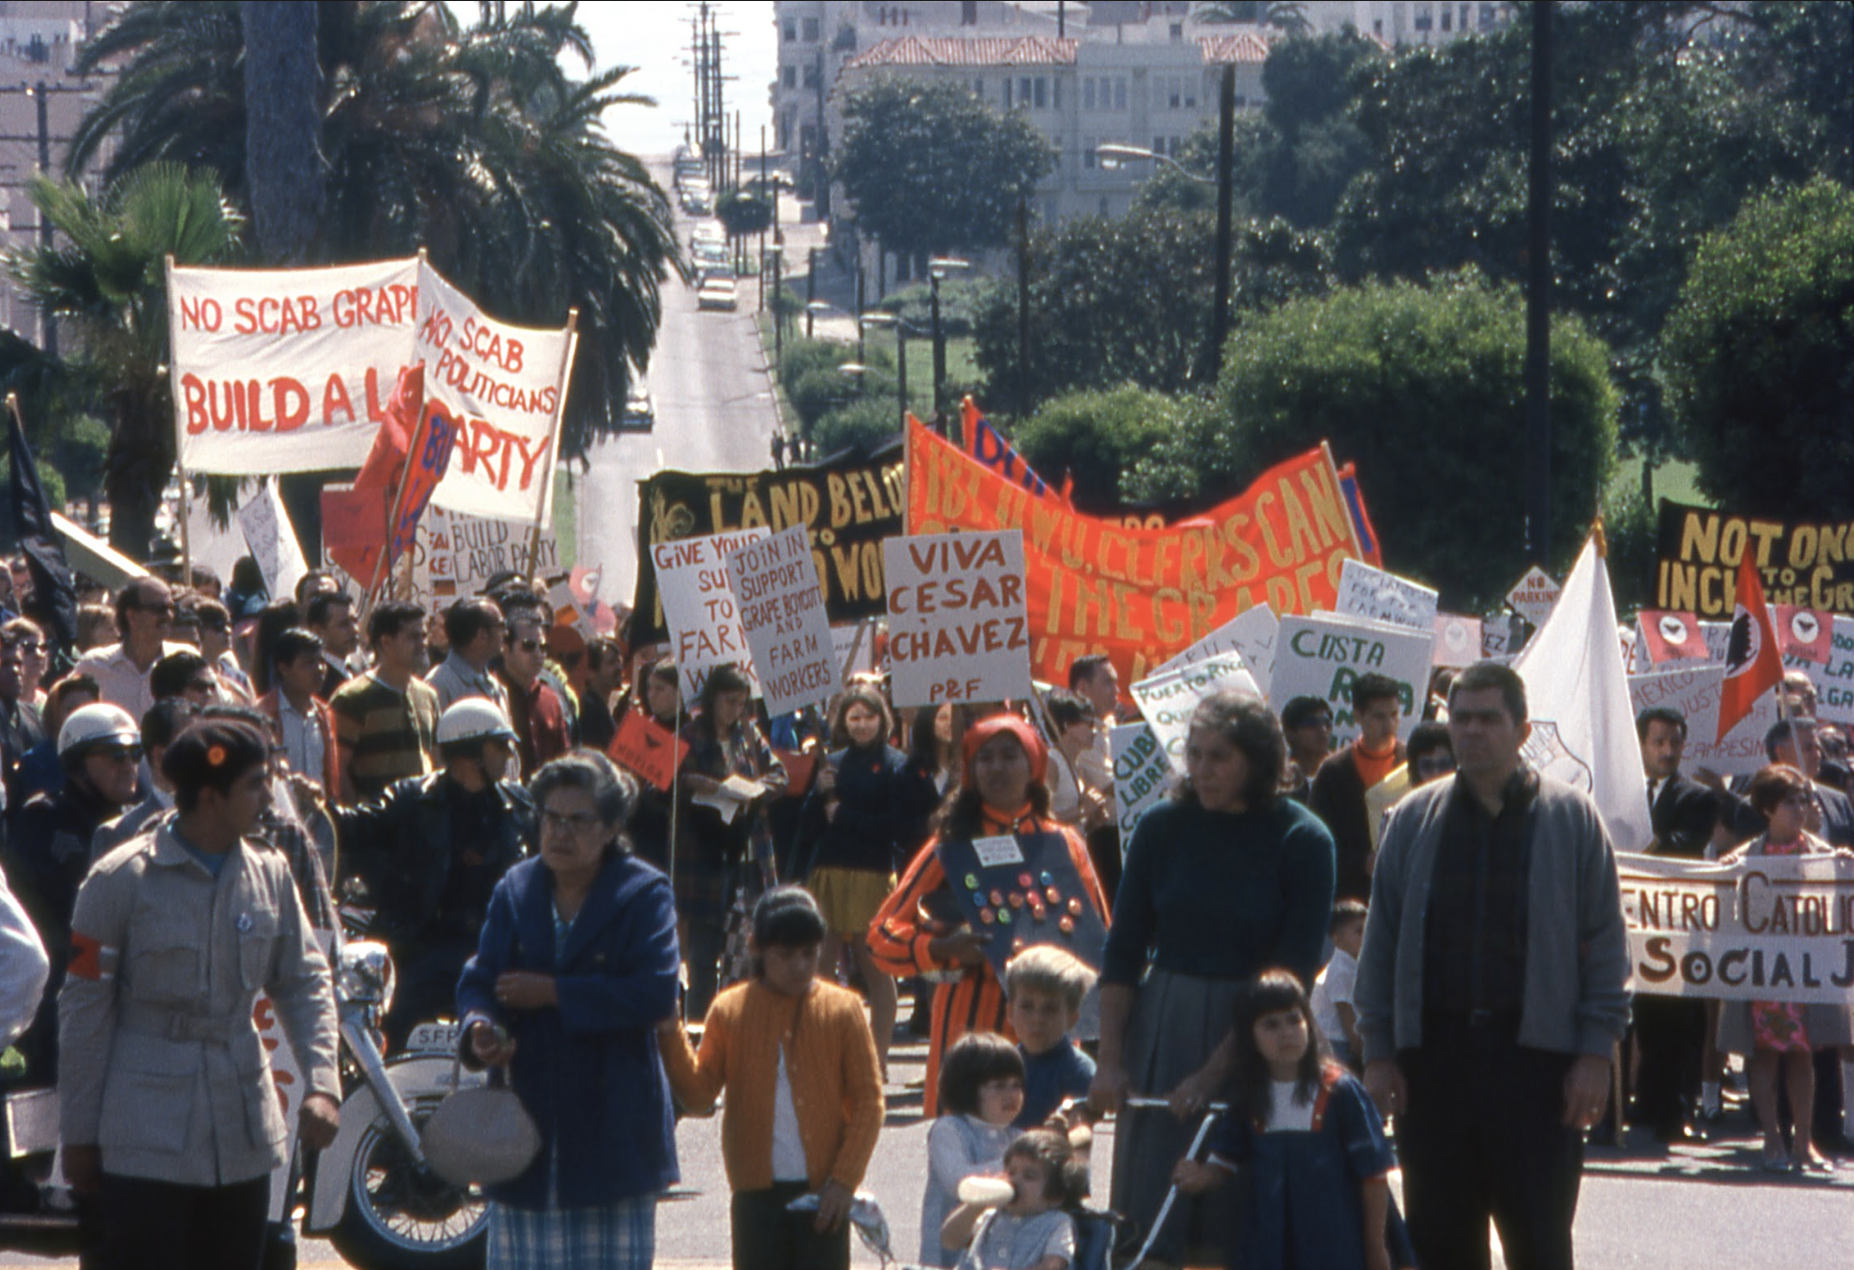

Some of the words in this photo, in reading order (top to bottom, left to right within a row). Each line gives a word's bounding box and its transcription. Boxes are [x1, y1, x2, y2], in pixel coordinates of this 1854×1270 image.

[181, 296, 222, 332] NO
[235, 295, 321, 335] SCAB
[418, 304, 453, 349] NO
[459, 316, 524, 374] SCAB
[434, 346, 557, 415] POLITICIANS
[181, 372, 310, 435] BUILD
[323, 373, 356, 426] A
[455, 414, 550, 492] ARTY
[711, 480, 819, 534] LAND
[1098, 514, 1260, 592] CLERKS
[1255, 460, 1349, 568] CAN
[452, 520, 508, 554] BUILD
[908, 538, 1006, 575] VIVA
[1680, 511, 1784, 569] NOT
[454, 548, 507, 583] LABOR
[740, 560, 803, 601] SUPPORT
[1526, 576, 1546, 589] NO
[1761, 567, 1796, 587] TO
[740, 597, 779, 632] GRAPE
[783, 585, 823, 622] BOYCOTT
[889, 574, 1022, 615] CESAR
[1811, 564, 1854, 613] GR
[704, 600, 733, 622] TO
[775, 616, 803, 636] AND
[769, 632, 819, 669] FARM
[766, 658, 832, 701] WORKERS
[929, 678, 982, 703] P&F
[1138, 674, 1207, 705] PUERTO
[1207, 659, 1245, 681] RICO
[1630, 670, 1694, 709] MEXICO
[1680, 738, 1767, 761] CAMPESIN
[1621, 887, 1720, 932] ENTRO
[1638, 937, 1822, 986] SOCIAL
